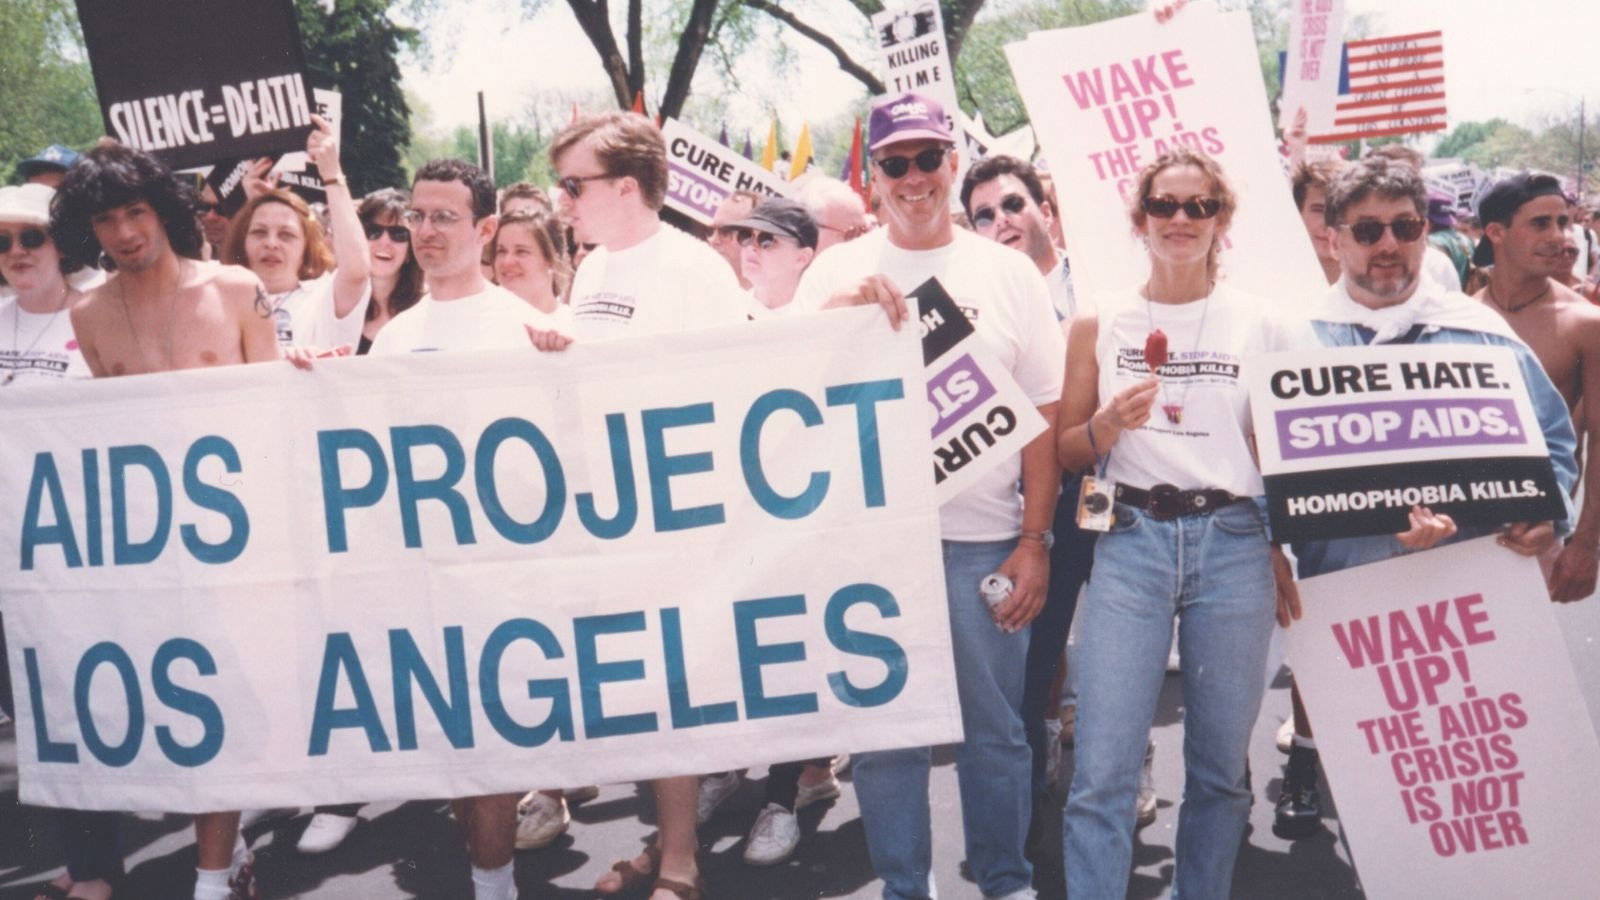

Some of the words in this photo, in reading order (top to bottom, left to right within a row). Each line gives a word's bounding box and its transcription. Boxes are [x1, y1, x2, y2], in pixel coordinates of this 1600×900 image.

[887, 40, 940, 69] KILLING
[894, 66, 942, 93] TIME
[1062, 49, 1195, 110] WAKE
[109, 73, 312, 150] SILENCE=DEATH
[1102, 94, 1183, 144] UP!
[670, 137, 735, 183] CURE
[1088, 145, 1144, 181] THE
[667, 168, 725, 211] STOP
[1199, 361, 1238, 376] KILLS.
[1270, 363, 1393, 399] CURE
[1400, 361, 1512, 391] HATE.
[933, 405, 1017, 486] CUR
[1288, 410, 1403, 449] STOP
[1409, 405, 1520, 441] AIDS.
[19, 434, 250, 571] AIDS
[317, 377, 905, 554] PROJECT
[1287, 483, 1467, 516] HOMOPHOBIA
[1471, 479, 1547, 501] KILLS.
[1330, 593, 1496, 670] WAKE
[23, 637, 226, 768] LOS
[307, 582, 909, 756] ANGELES
[1376, 649, 1478, 712] UP!
[1356, 711, 1430, 755] THE
[1438, 691, 1529, 742] AIDS
[1390, 733, 1519, 788] CRISIS
[1400, 786, 1443, 825] IS
[1451, 771, 1525, 818] NOT
[1428, 809, 1530, 858] OVER
